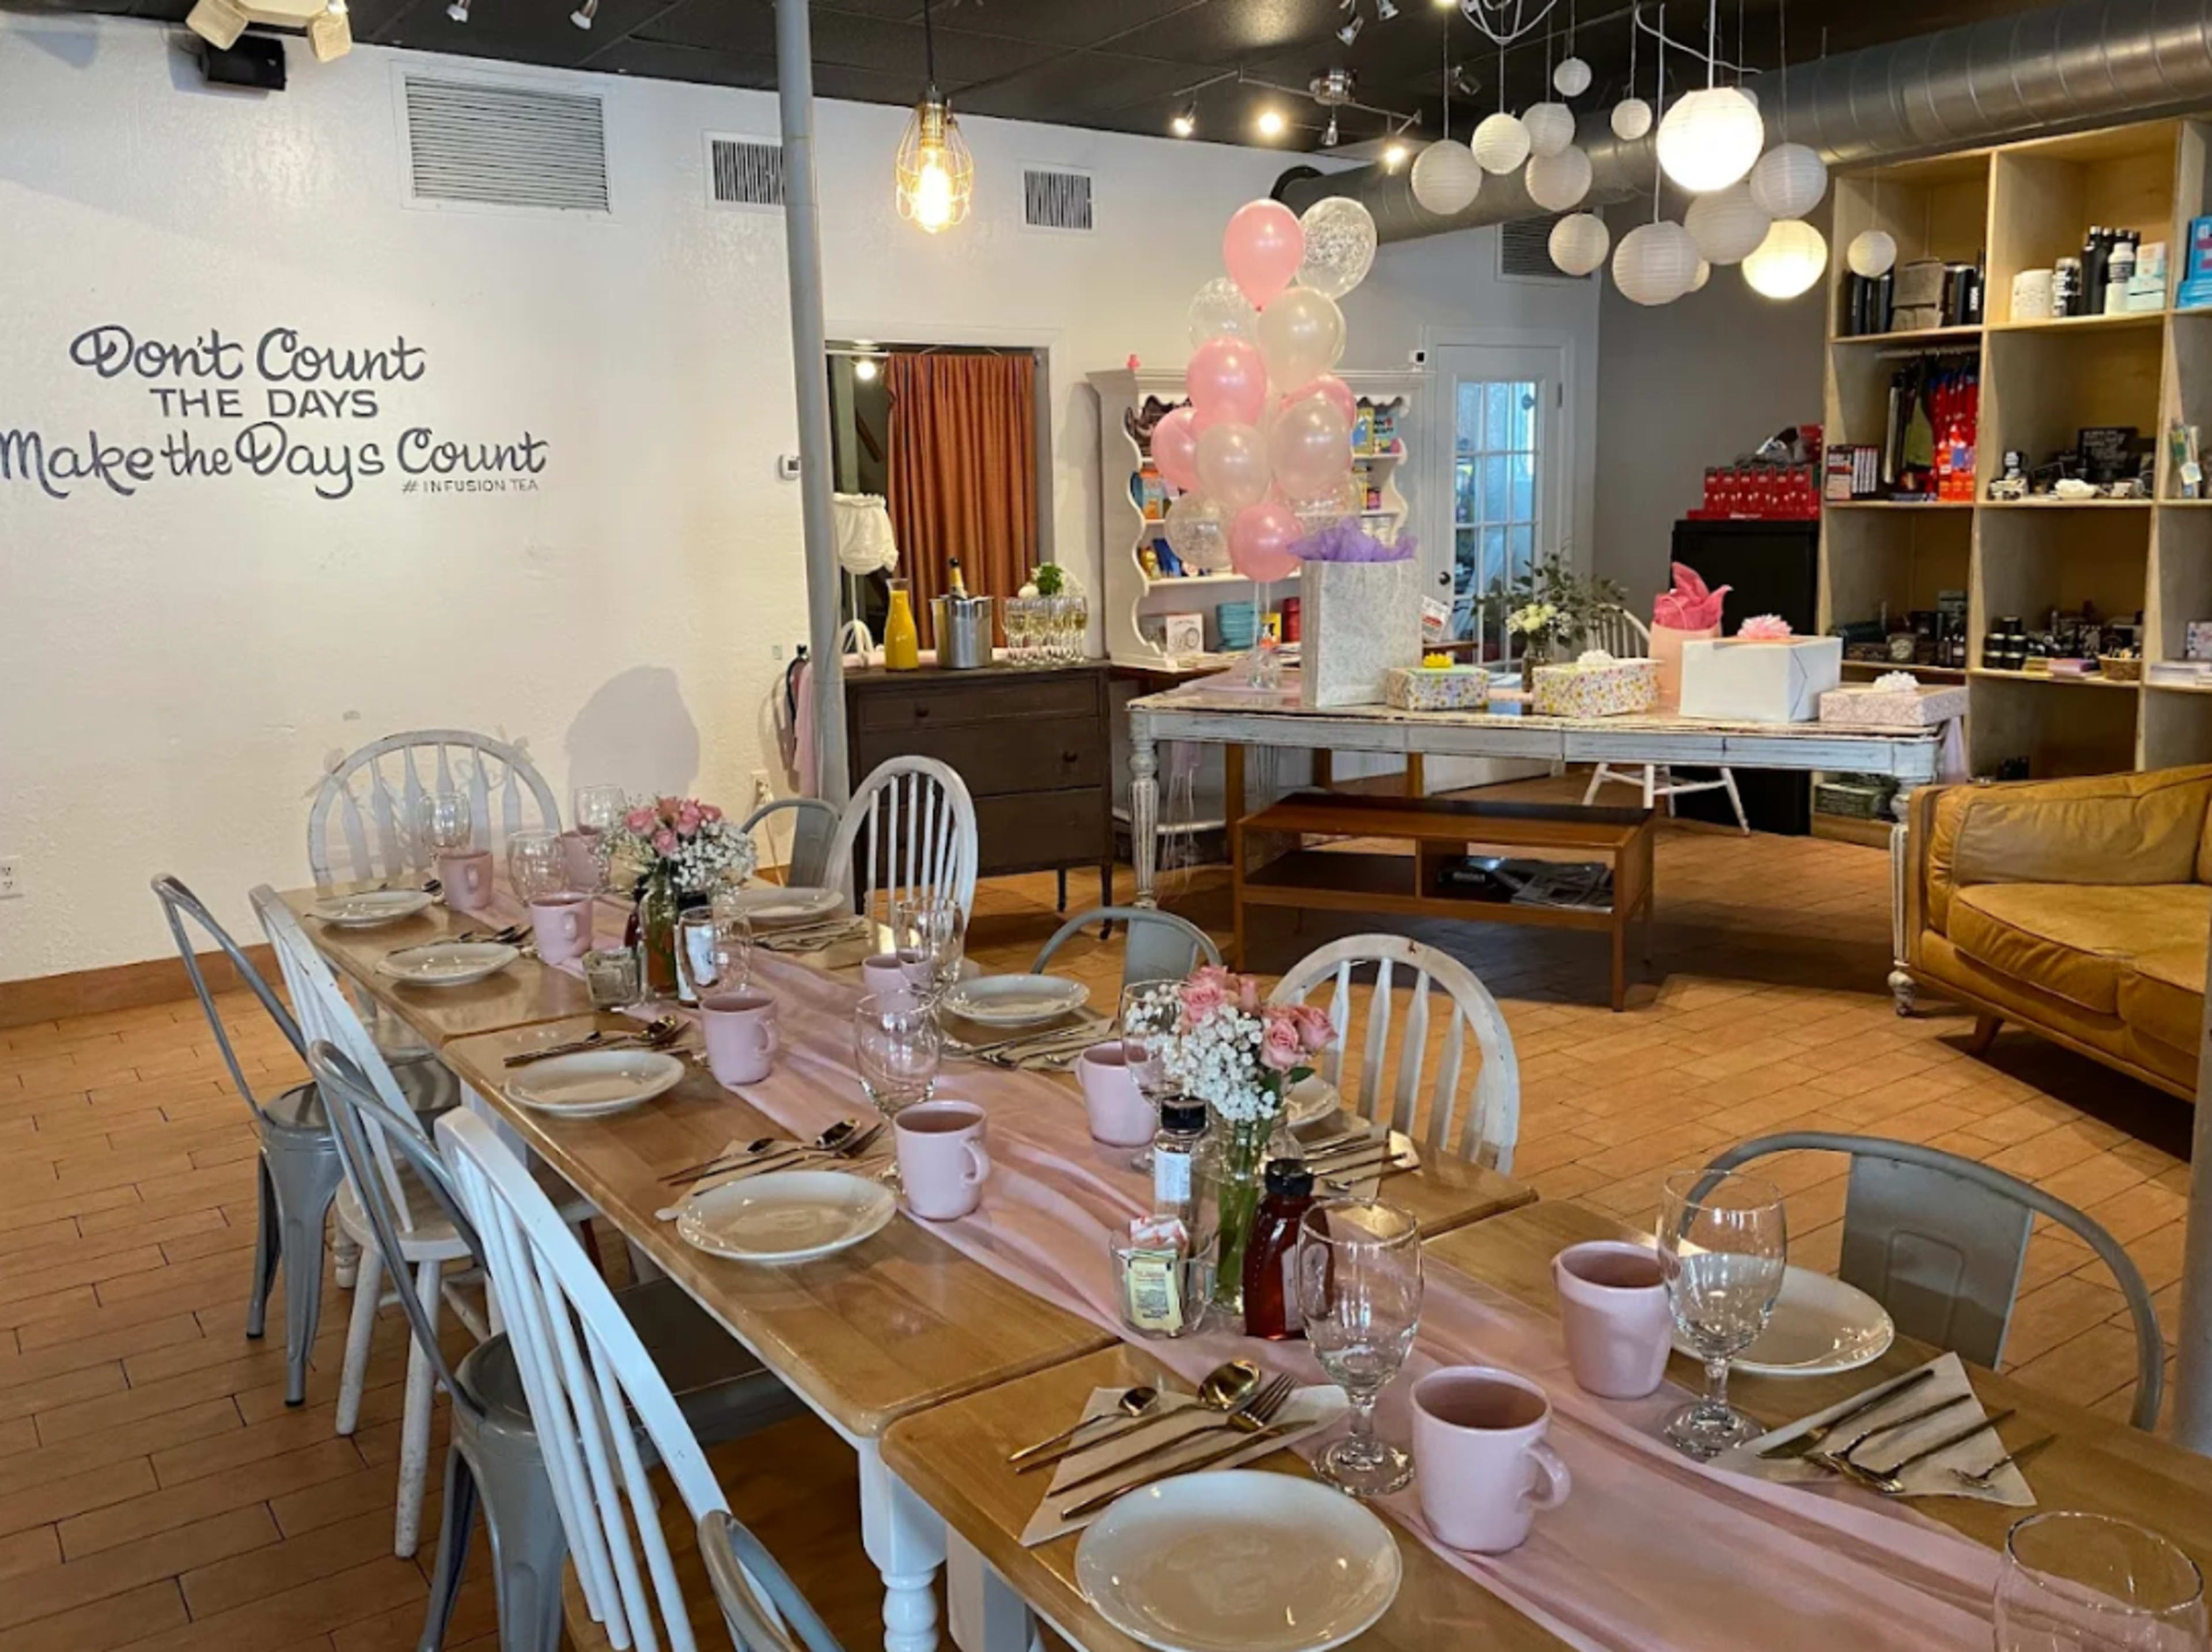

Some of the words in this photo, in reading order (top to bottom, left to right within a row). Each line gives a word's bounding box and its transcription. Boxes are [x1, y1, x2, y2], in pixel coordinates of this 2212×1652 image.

[70, 325, 244, 378] Don't
[256, 327, 426, 381] Count
[149, 389, 244, 418] THE
[267, 389, 380, 418] DAYS
[0, 429, 154, 499] Make
[161, 430, 232, 476] the
[234, 421, 386, 499] Days
[397, 427, 549, 473] Count
[510, 479, 539, 492] TEA
